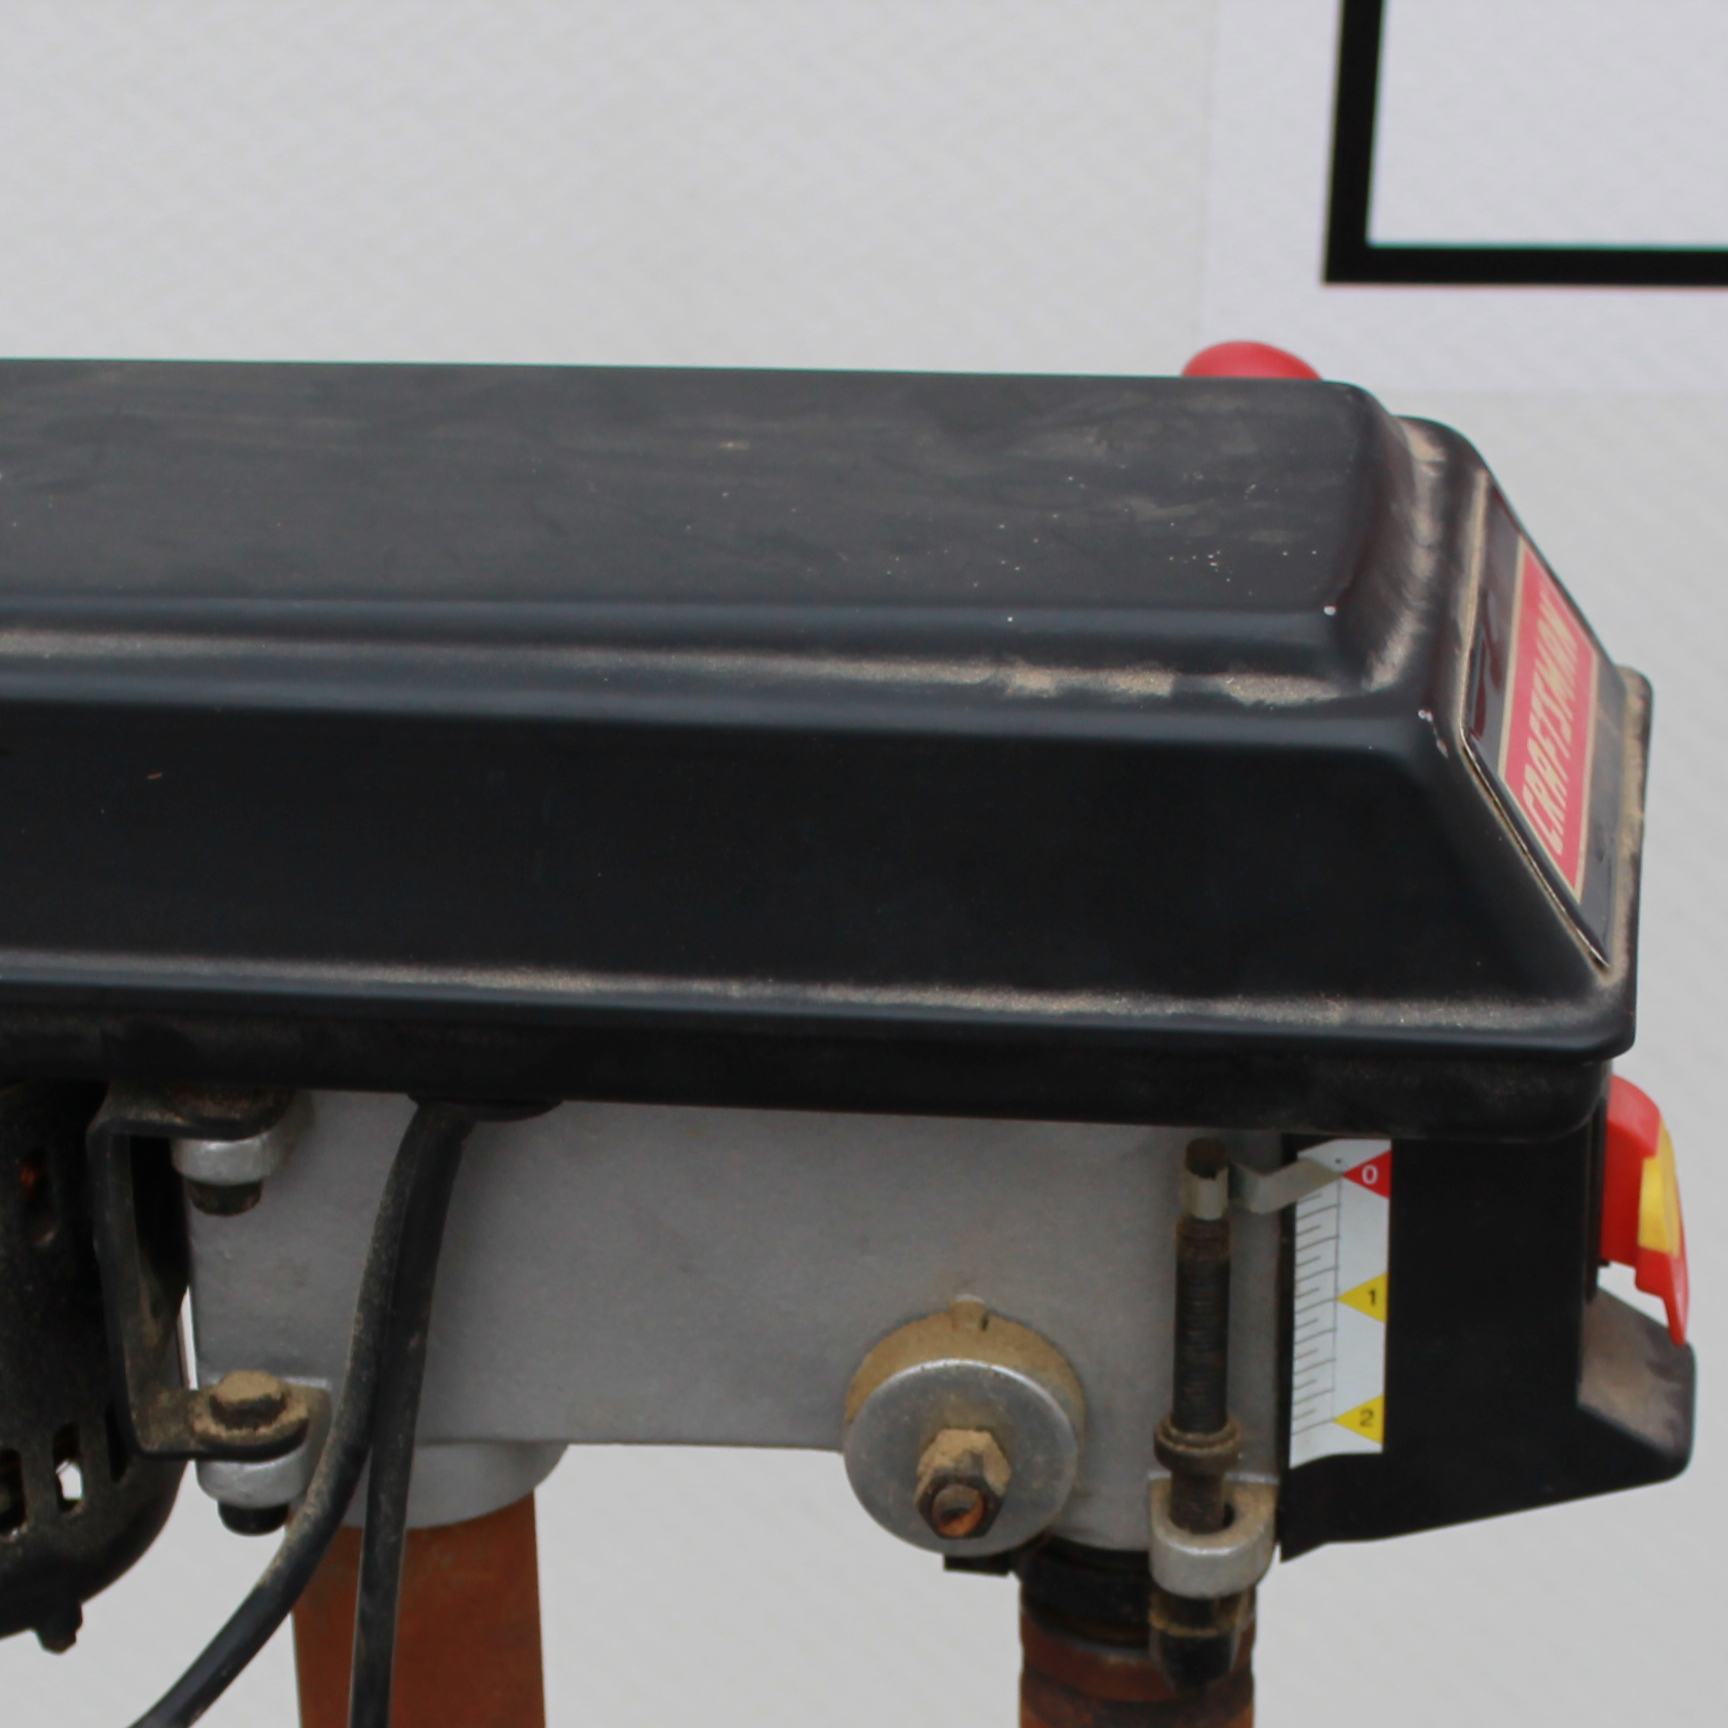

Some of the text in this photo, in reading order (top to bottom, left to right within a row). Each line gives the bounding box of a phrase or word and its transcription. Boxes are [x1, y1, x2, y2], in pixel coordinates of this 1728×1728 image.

[1521, 587, 1578, 857] CRAFTSMAN
[1361, 1164, 1379, 1186] 0
[1367, 1288, 1377, 1306] 1
[1358, 1407, 1374, 1428] 2
